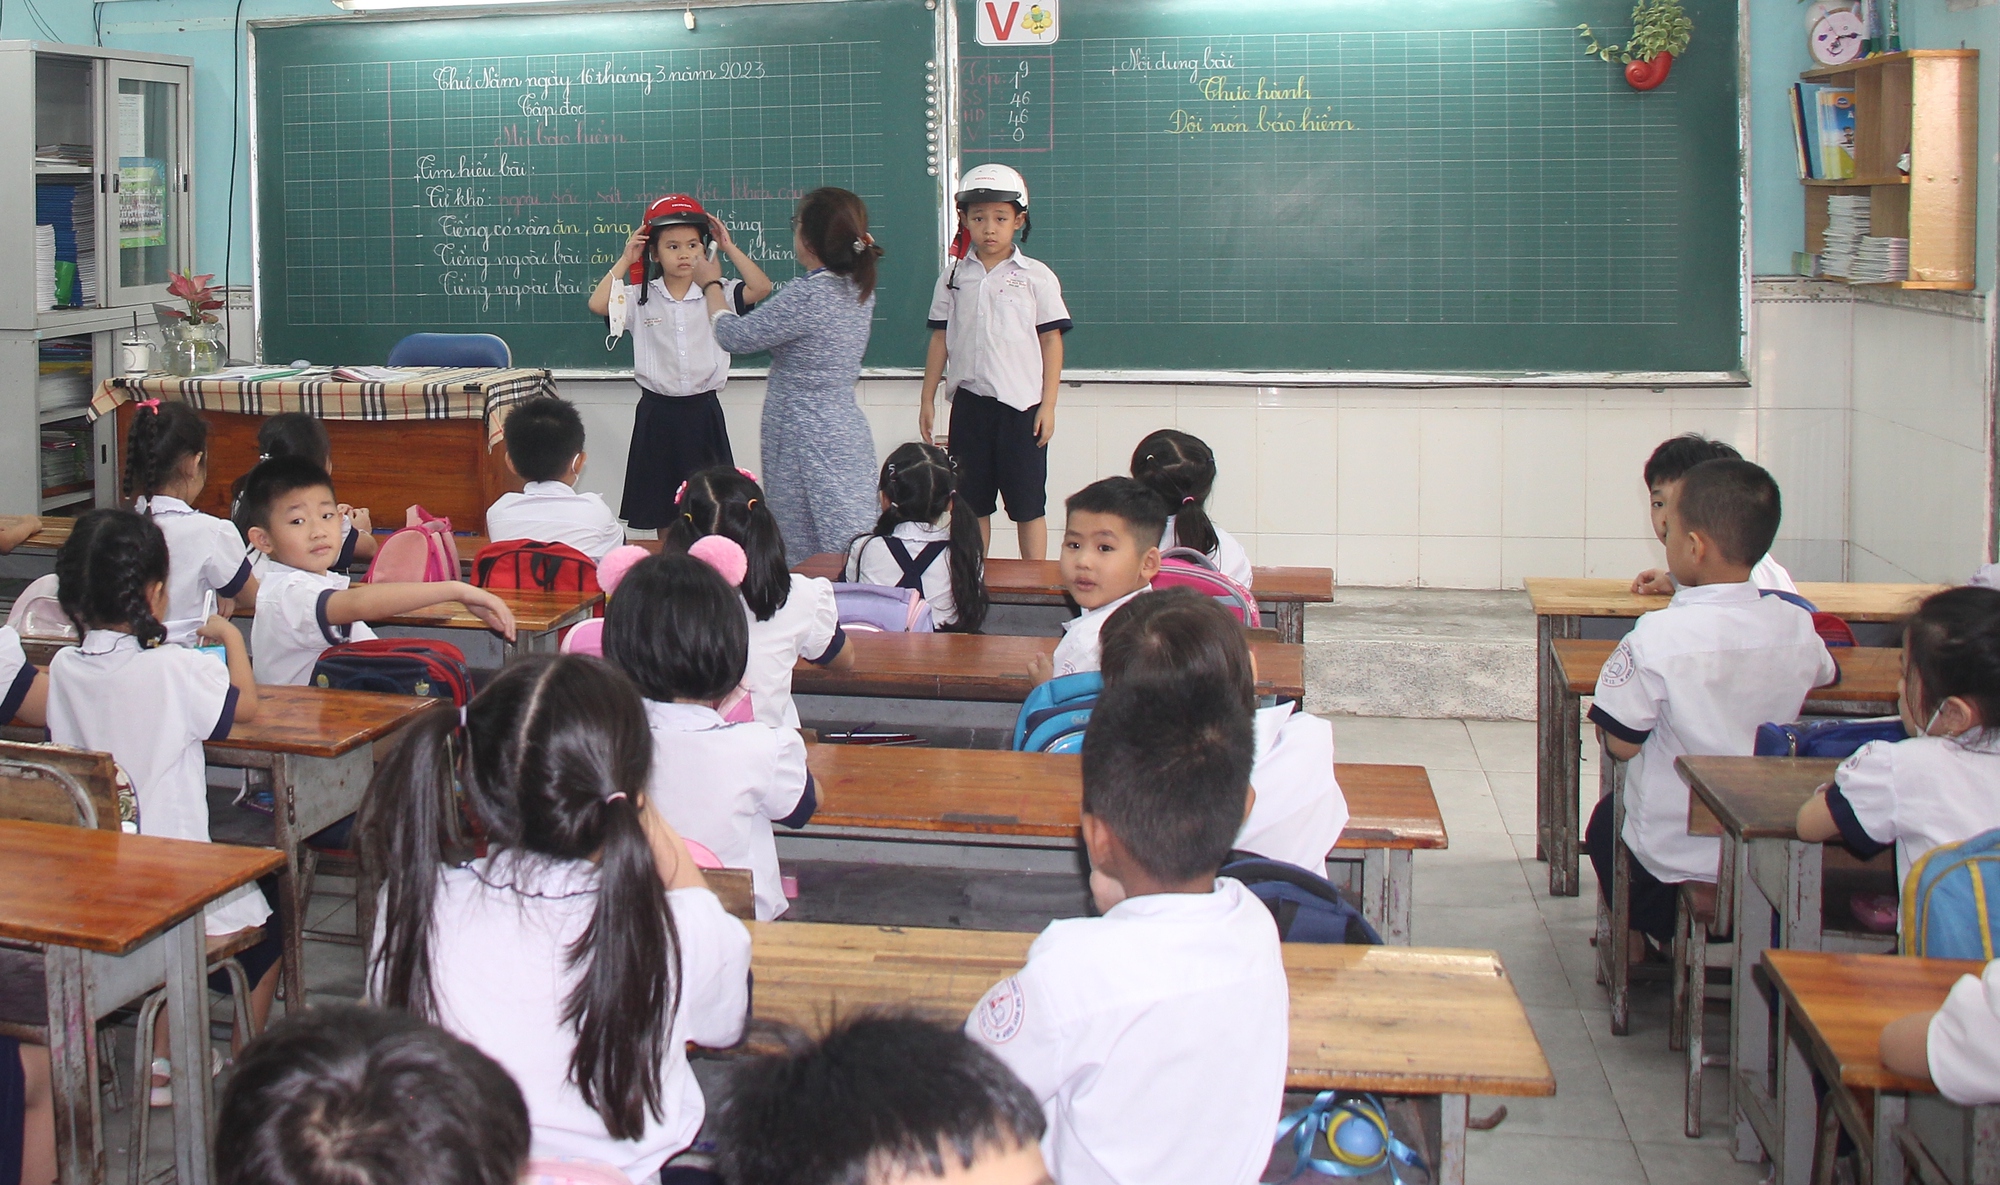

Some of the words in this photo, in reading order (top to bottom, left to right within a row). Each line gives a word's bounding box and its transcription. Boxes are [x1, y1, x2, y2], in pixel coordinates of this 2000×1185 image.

[985, 2, 1020, 41] V
[433, 65, 473, 91] Thứ
[475, 66, 522, 90] Năm
[524, 70, 573, 101] ngày
[577, 67, 595, 85] 16
[596, 61, 653, 96] tháng
[655, 64, 667, 83] 3
[668, 67, 717, 82] năm
[720, 61, 766, 80] 2023
[1121, 47, 1153, 78] Nội
[1155, 50, 1199, 84] dung
[1201, 46, 1236, 70] bài
[1009, 90, 1031, 108] 46
[1254, 75, 1312, 101] hành
[517, 92, 557, 127] Tập
[559, 101, 587, 123] đọc
[1008, 108, 1029, 127] 46
[1210, 115, 1249, 133] nón
[416, 154, 456, 180] Tìm
[437, 214, 492, 252] Tiếng
[493, 217, 512, 237] có
[514, 216, 551, 236] vần
[433, 243, 491, 283] Tiếng
[494, 249, 549, 279] ngoài
[495, 278, 549, 312] ngoài
[551, 269, 583, 295] bài
